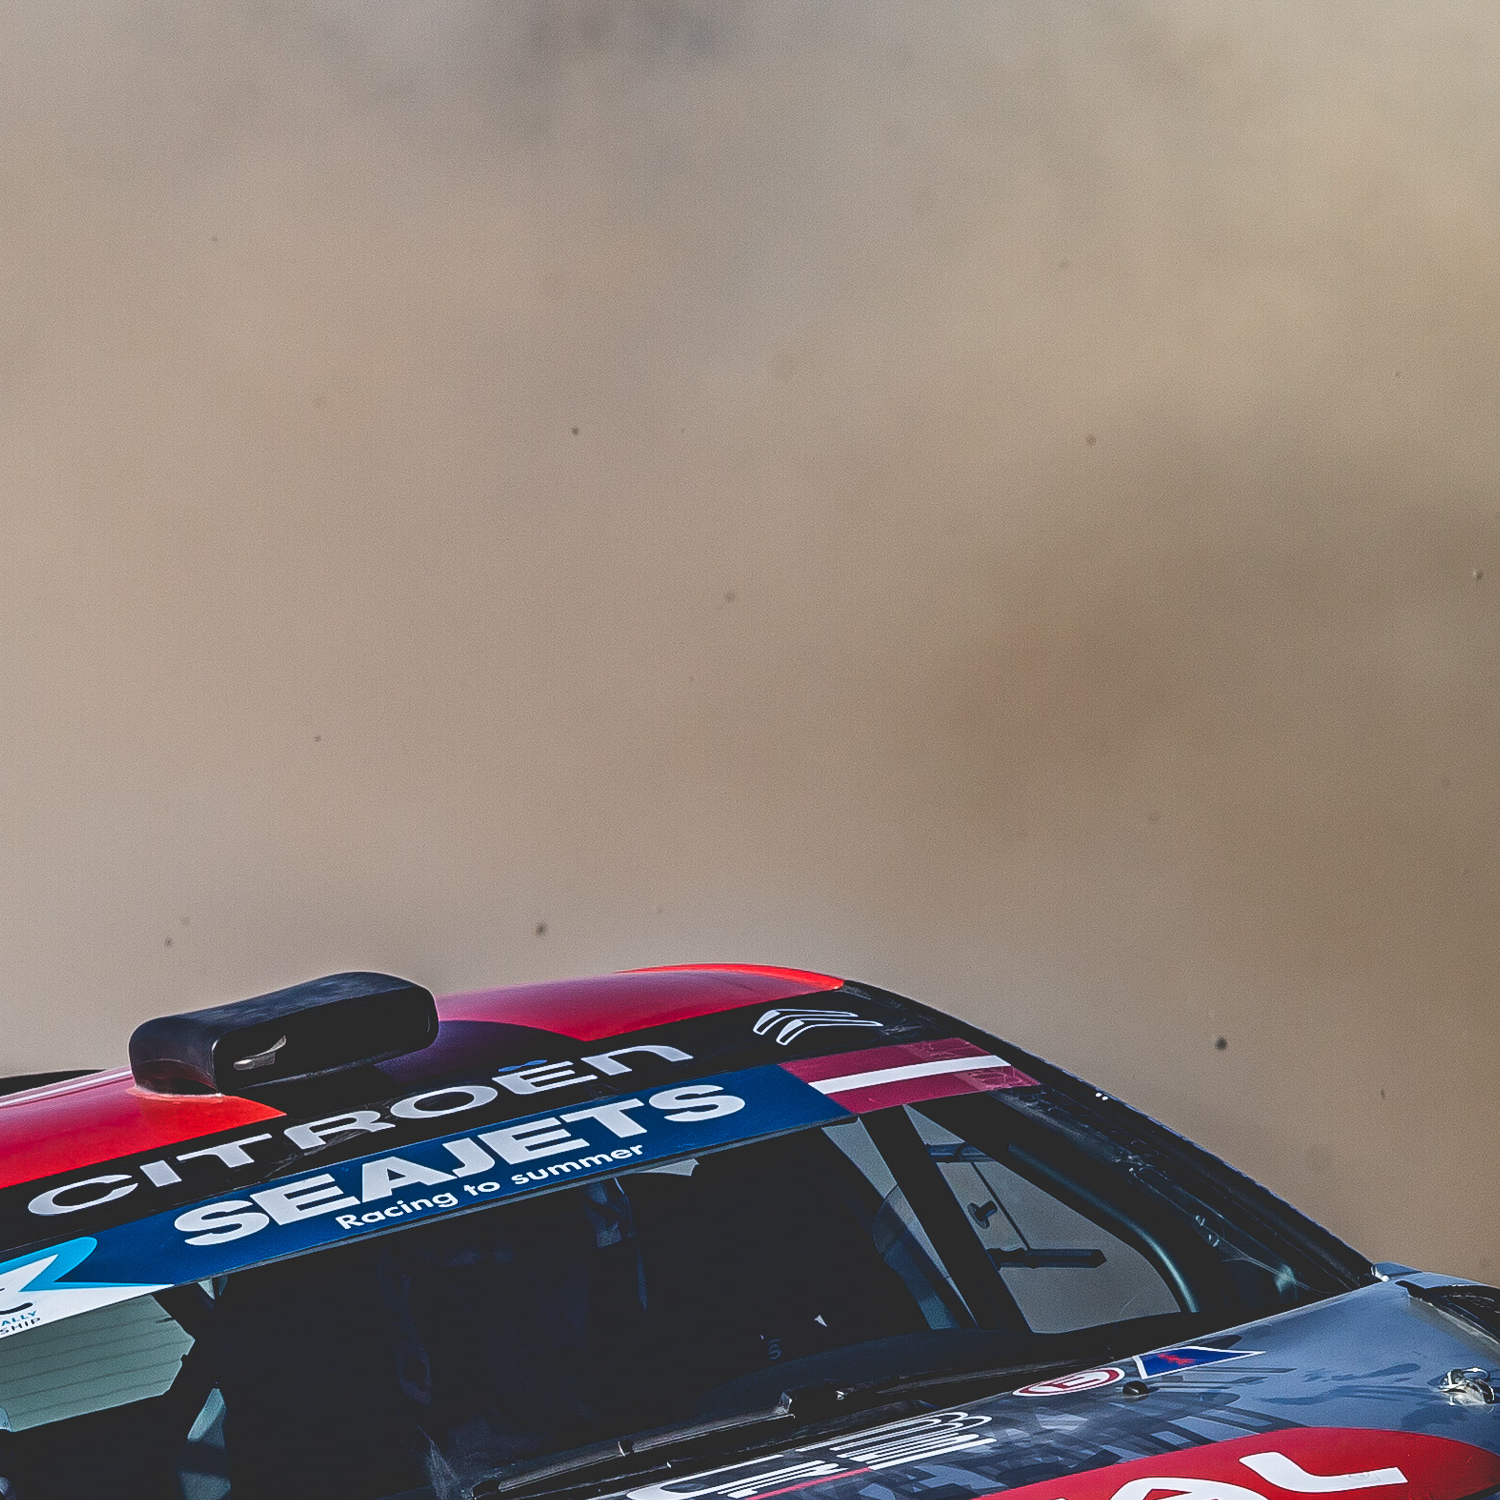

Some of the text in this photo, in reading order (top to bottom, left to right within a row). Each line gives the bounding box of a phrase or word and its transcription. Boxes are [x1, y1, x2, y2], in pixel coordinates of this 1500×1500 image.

[174, 1084, 746, 1246] SEAJETS
[335, 1144, 644, 1230] Racing to summer
